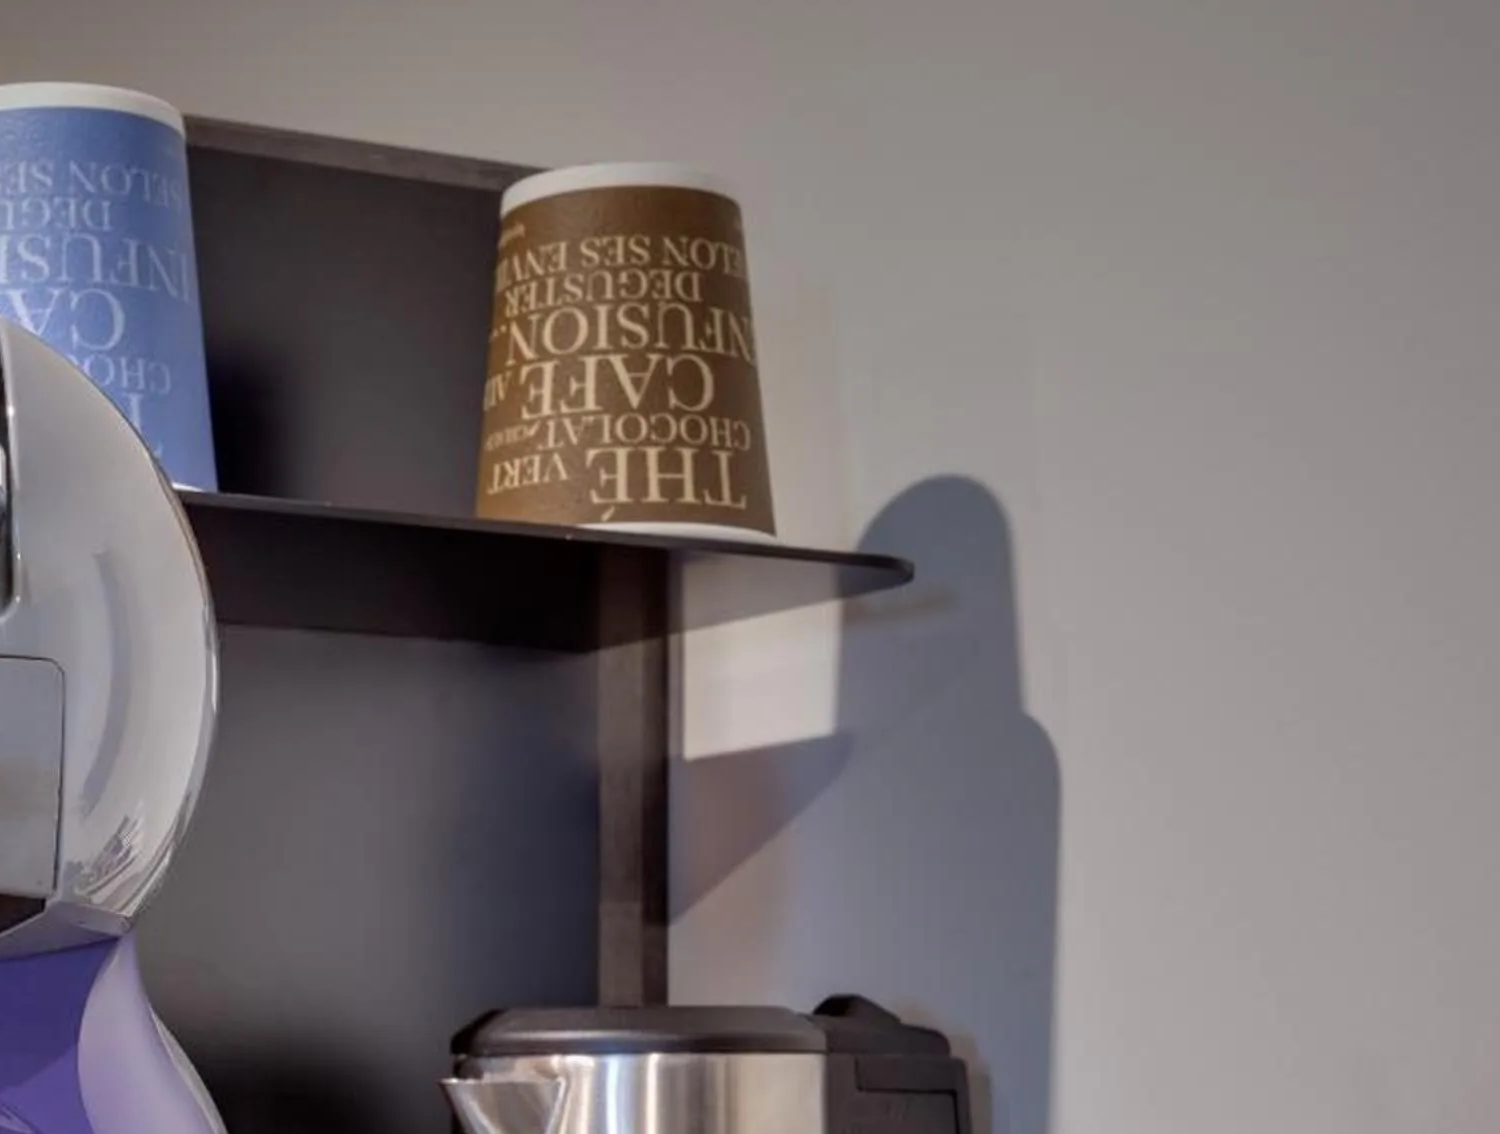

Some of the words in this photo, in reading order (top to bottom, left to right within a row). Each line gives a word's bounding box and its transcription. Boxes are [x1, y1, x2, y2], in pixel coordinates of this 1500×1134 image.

[580, 234, 650, 267] SES
[519, 353, 715, 437] CAFÉ
[538, 412, 750, 450] CHOCOLAT
[487, 452, 569, 495] VERT
[587, 446, 747, 522] THÉ
